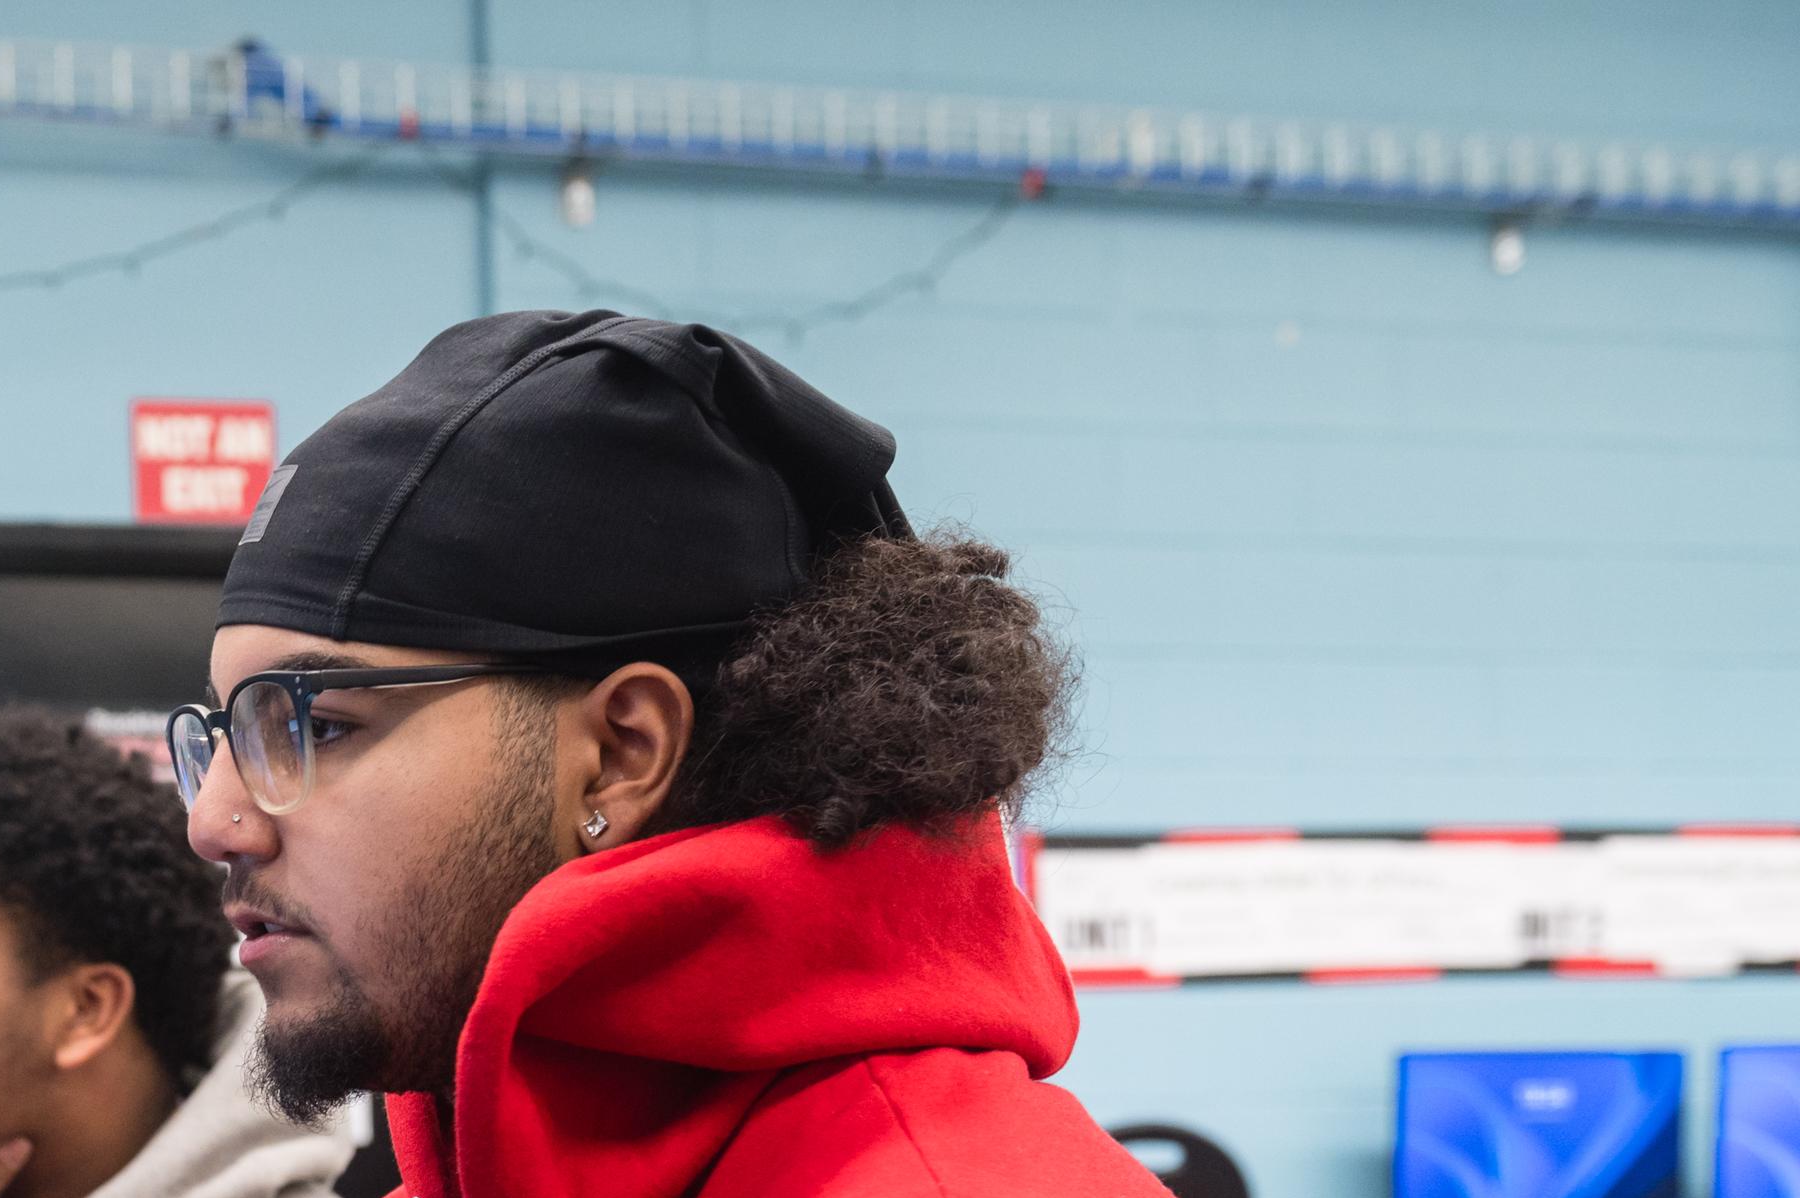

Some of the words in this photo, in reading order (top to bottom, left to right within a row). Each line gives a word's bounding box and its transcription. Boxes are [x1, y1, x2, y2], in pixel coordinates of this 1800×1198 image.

[138, 416, 211, 460] NOT
[217, 416, 270, 461] AN
[162, 466, 246, 511] EXIT
